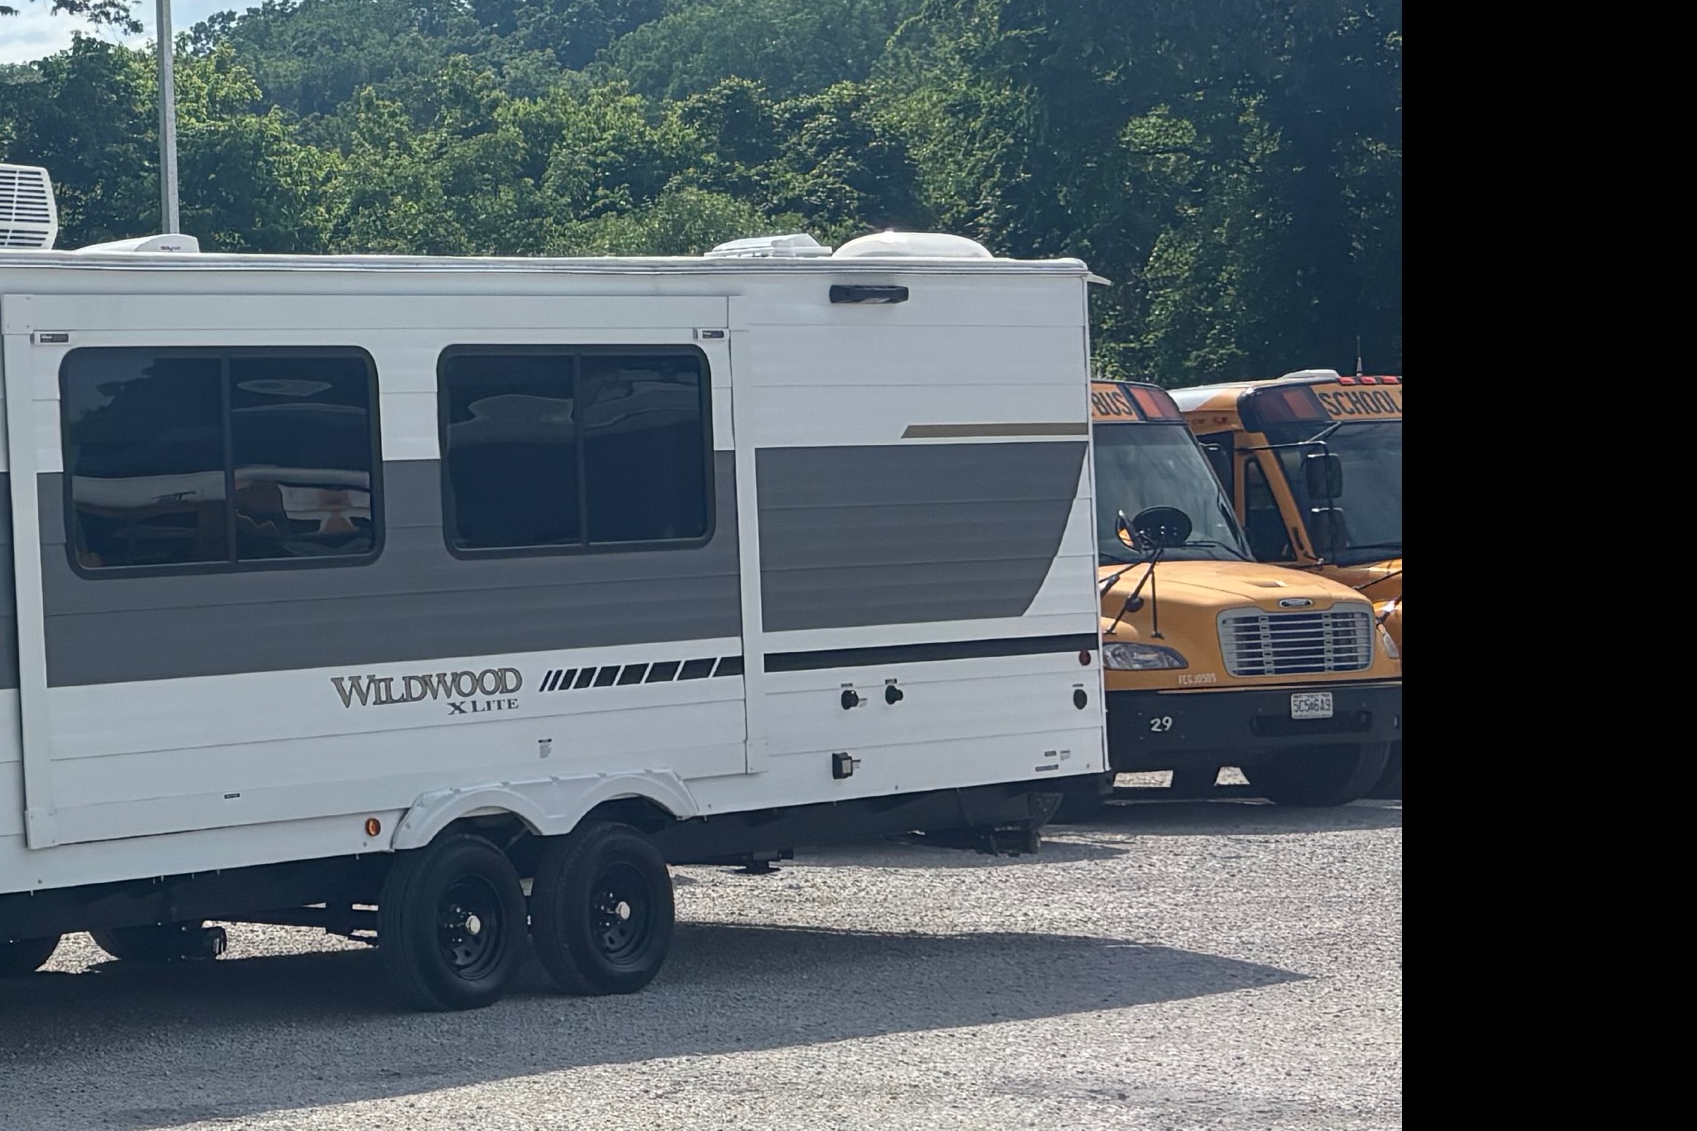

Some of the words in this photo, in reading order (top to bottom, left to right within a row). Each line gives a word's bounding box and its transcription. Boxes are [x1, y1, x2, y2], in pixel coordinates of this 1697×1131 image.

[1091, 391, 1133, 416] BUS
[1318, 390, 1402, 416] SCHOOL
[330, 667, 523, 708] WILDWOOD
[1150, 716, 1173, 732] 29
